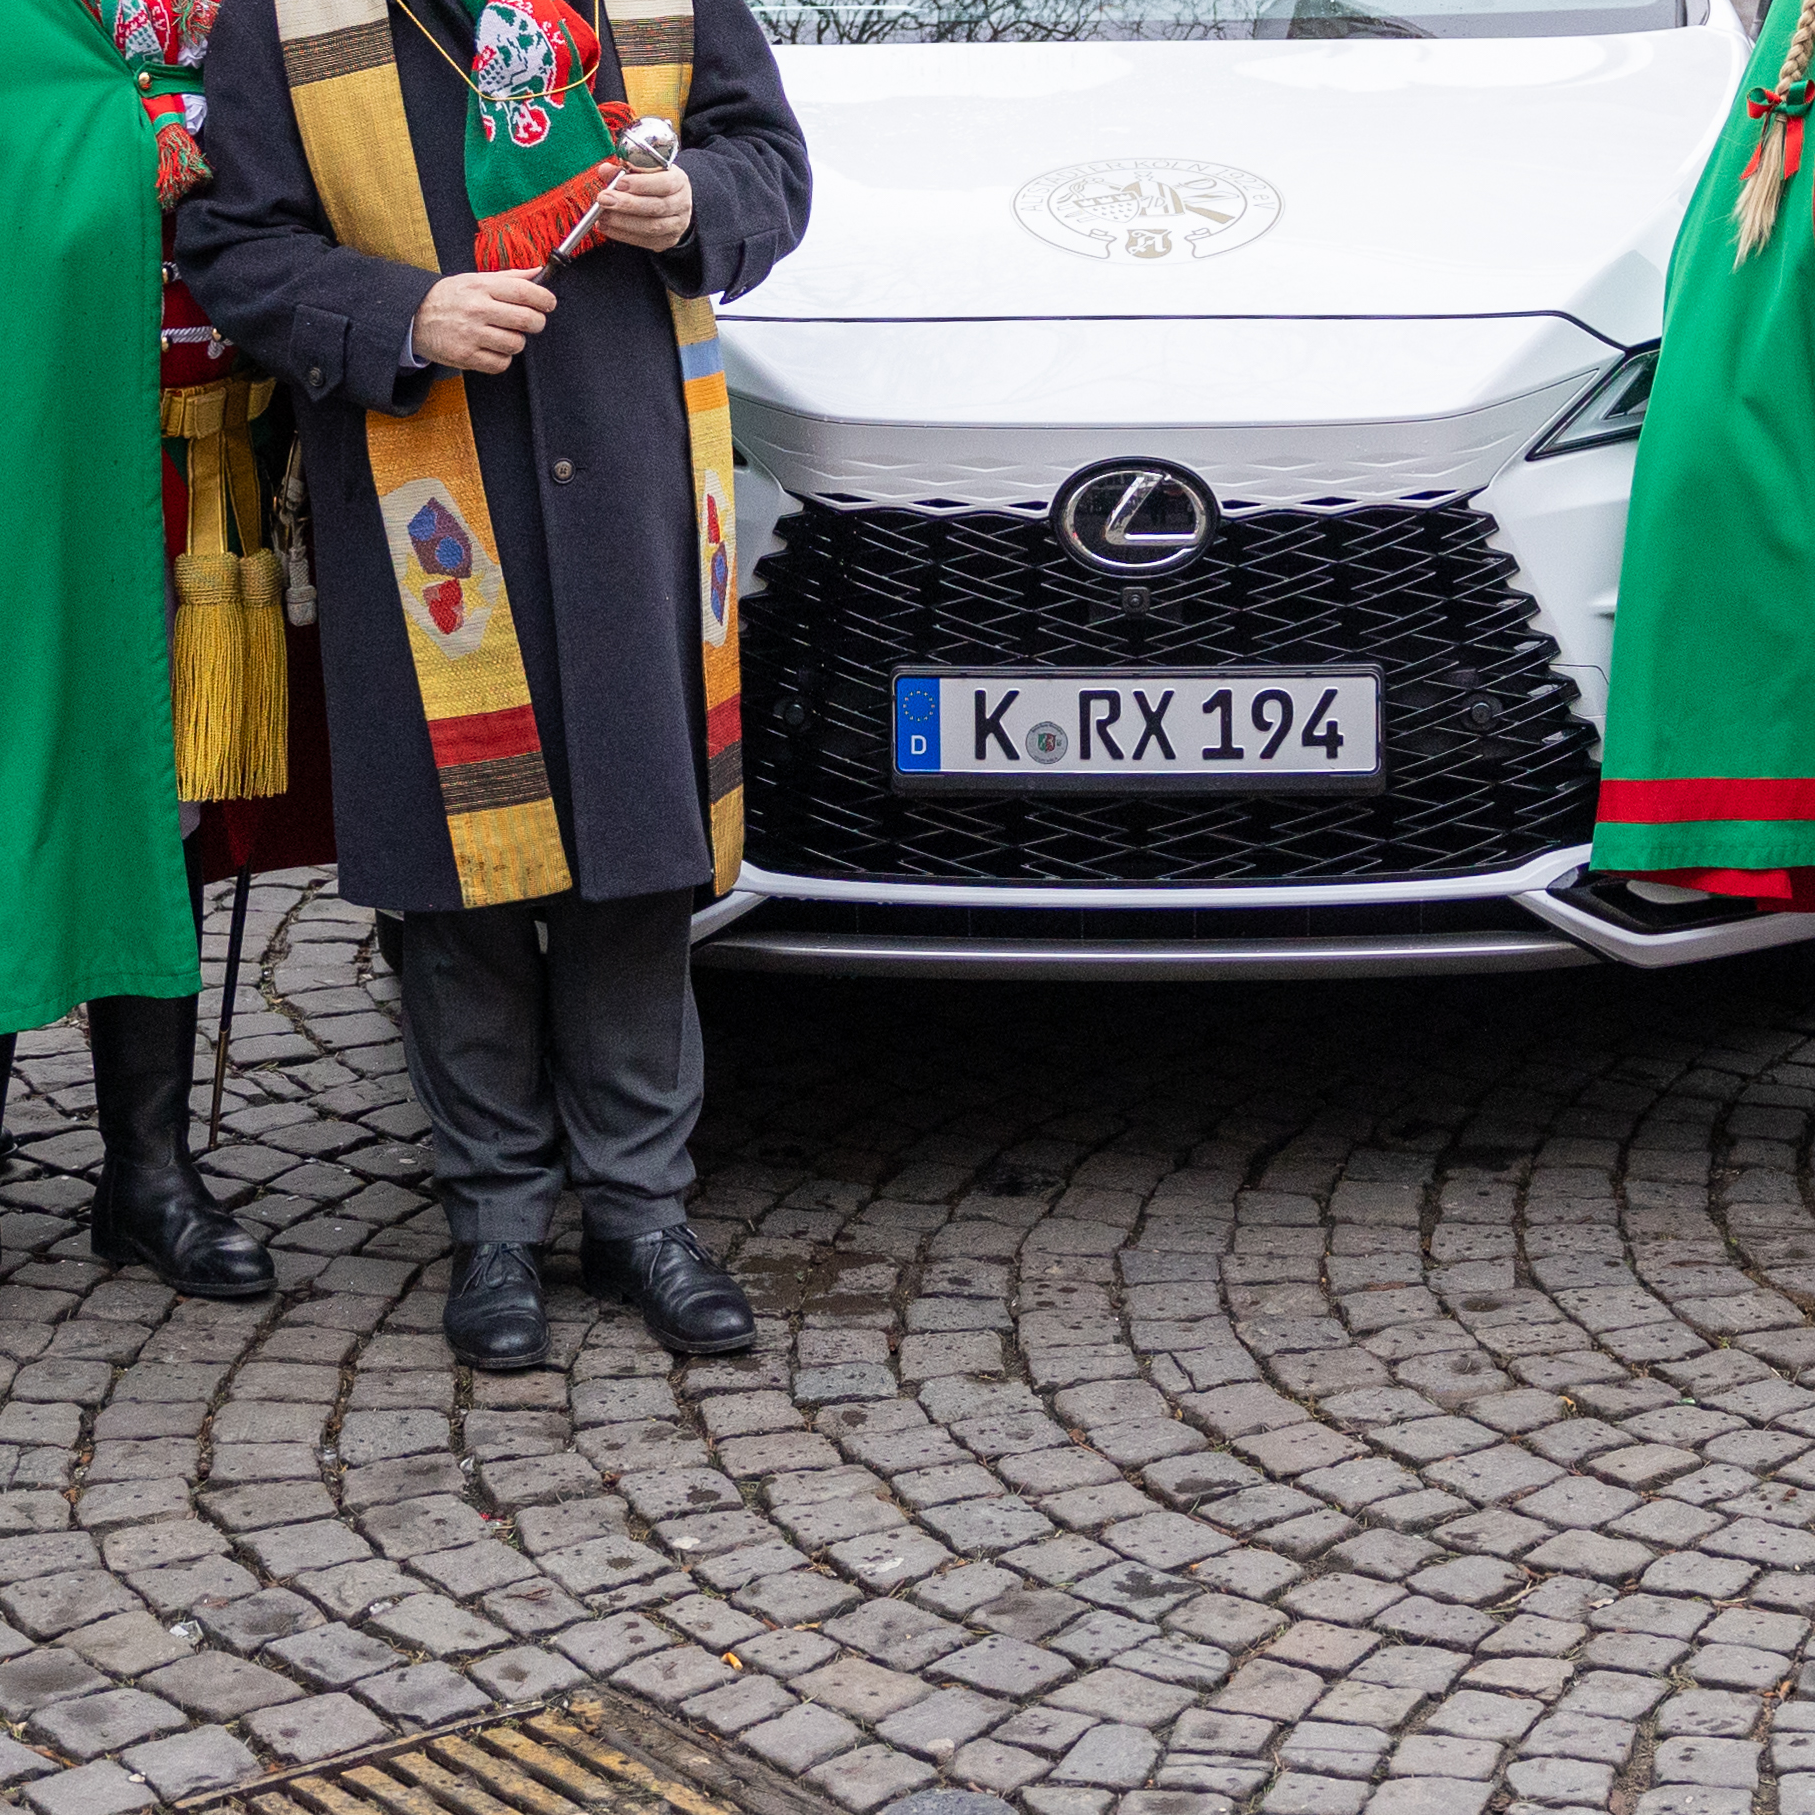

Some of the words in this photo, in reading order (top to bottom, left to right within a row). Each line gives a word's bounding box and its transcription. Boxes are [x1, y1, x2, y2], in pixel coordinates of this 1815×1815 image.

[1134, 159, 1210, 172] KÖLN
[1215, 169, 1266, 192] 1922
[973, 688, 1021, 761] K
[1078, 688, 1177, 761] RX
[1200, 688, 1344, 761] 194
[910, 734, 927, 755] D
